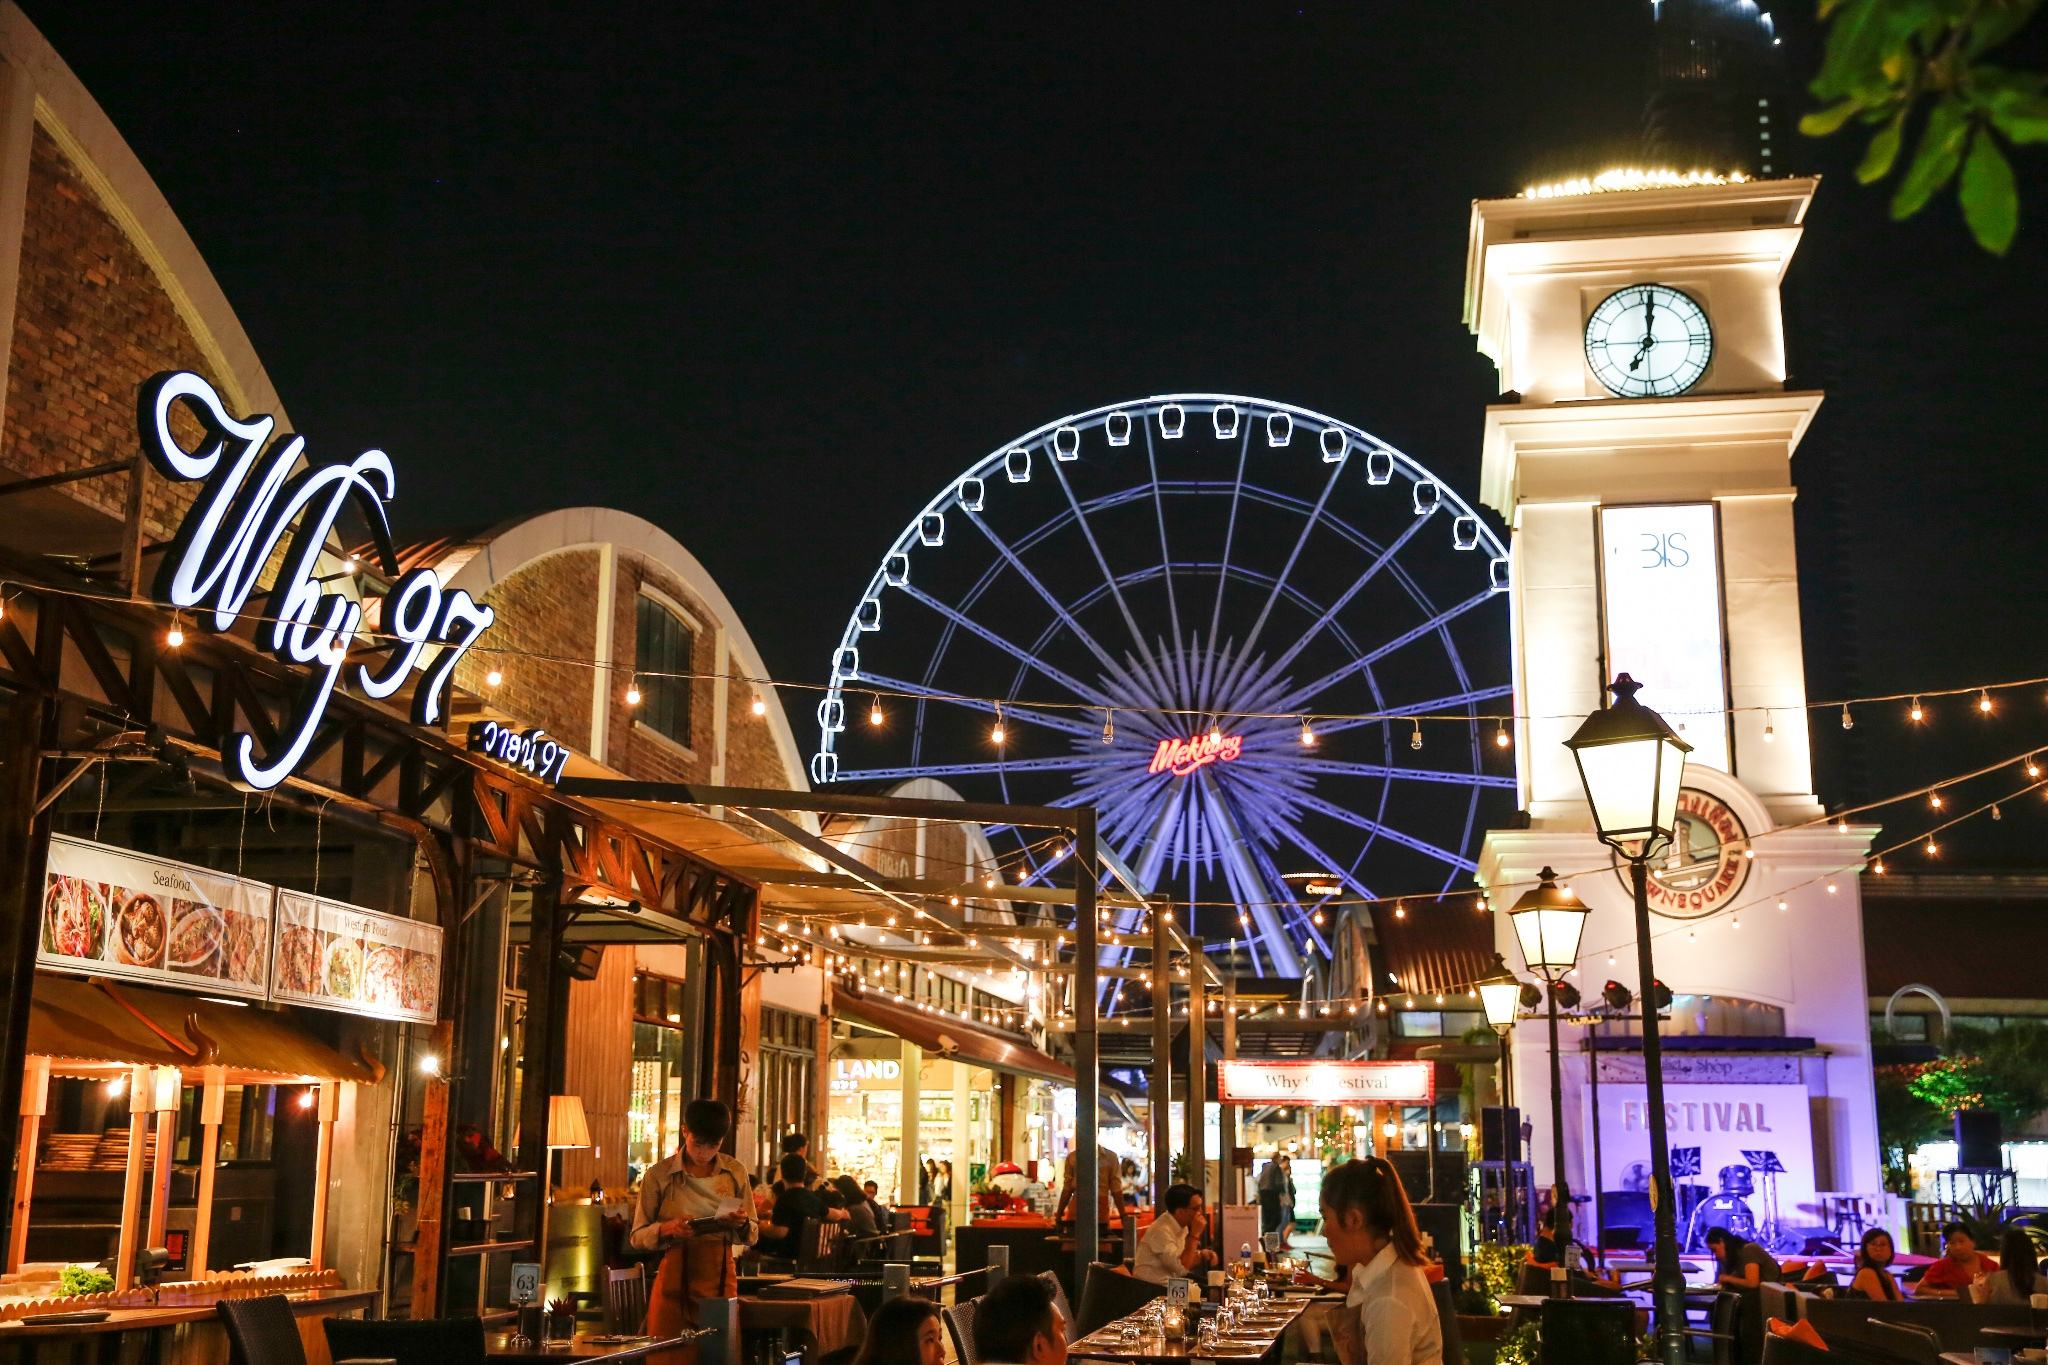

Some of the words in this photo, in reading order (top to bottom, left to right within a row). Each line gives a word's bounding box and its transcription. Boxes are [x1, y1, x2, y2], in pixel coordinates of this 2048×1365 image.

[154, 369, 396, 791] Why
[358, 568, 495, 725] 97
[484, 721, 545, 772] วายน์
[539, 741, 570, 784] 97
[152, 870, 191, 892] Seafood
[837, 1060, 900, 1080] LAND
[1266, 1074, 1301, 1093] Why
[1333, 1075, 1389, 1089] estival
[516, 1273, 535, 1290] 63
[1171, 1286, 1186, 1299] 65
